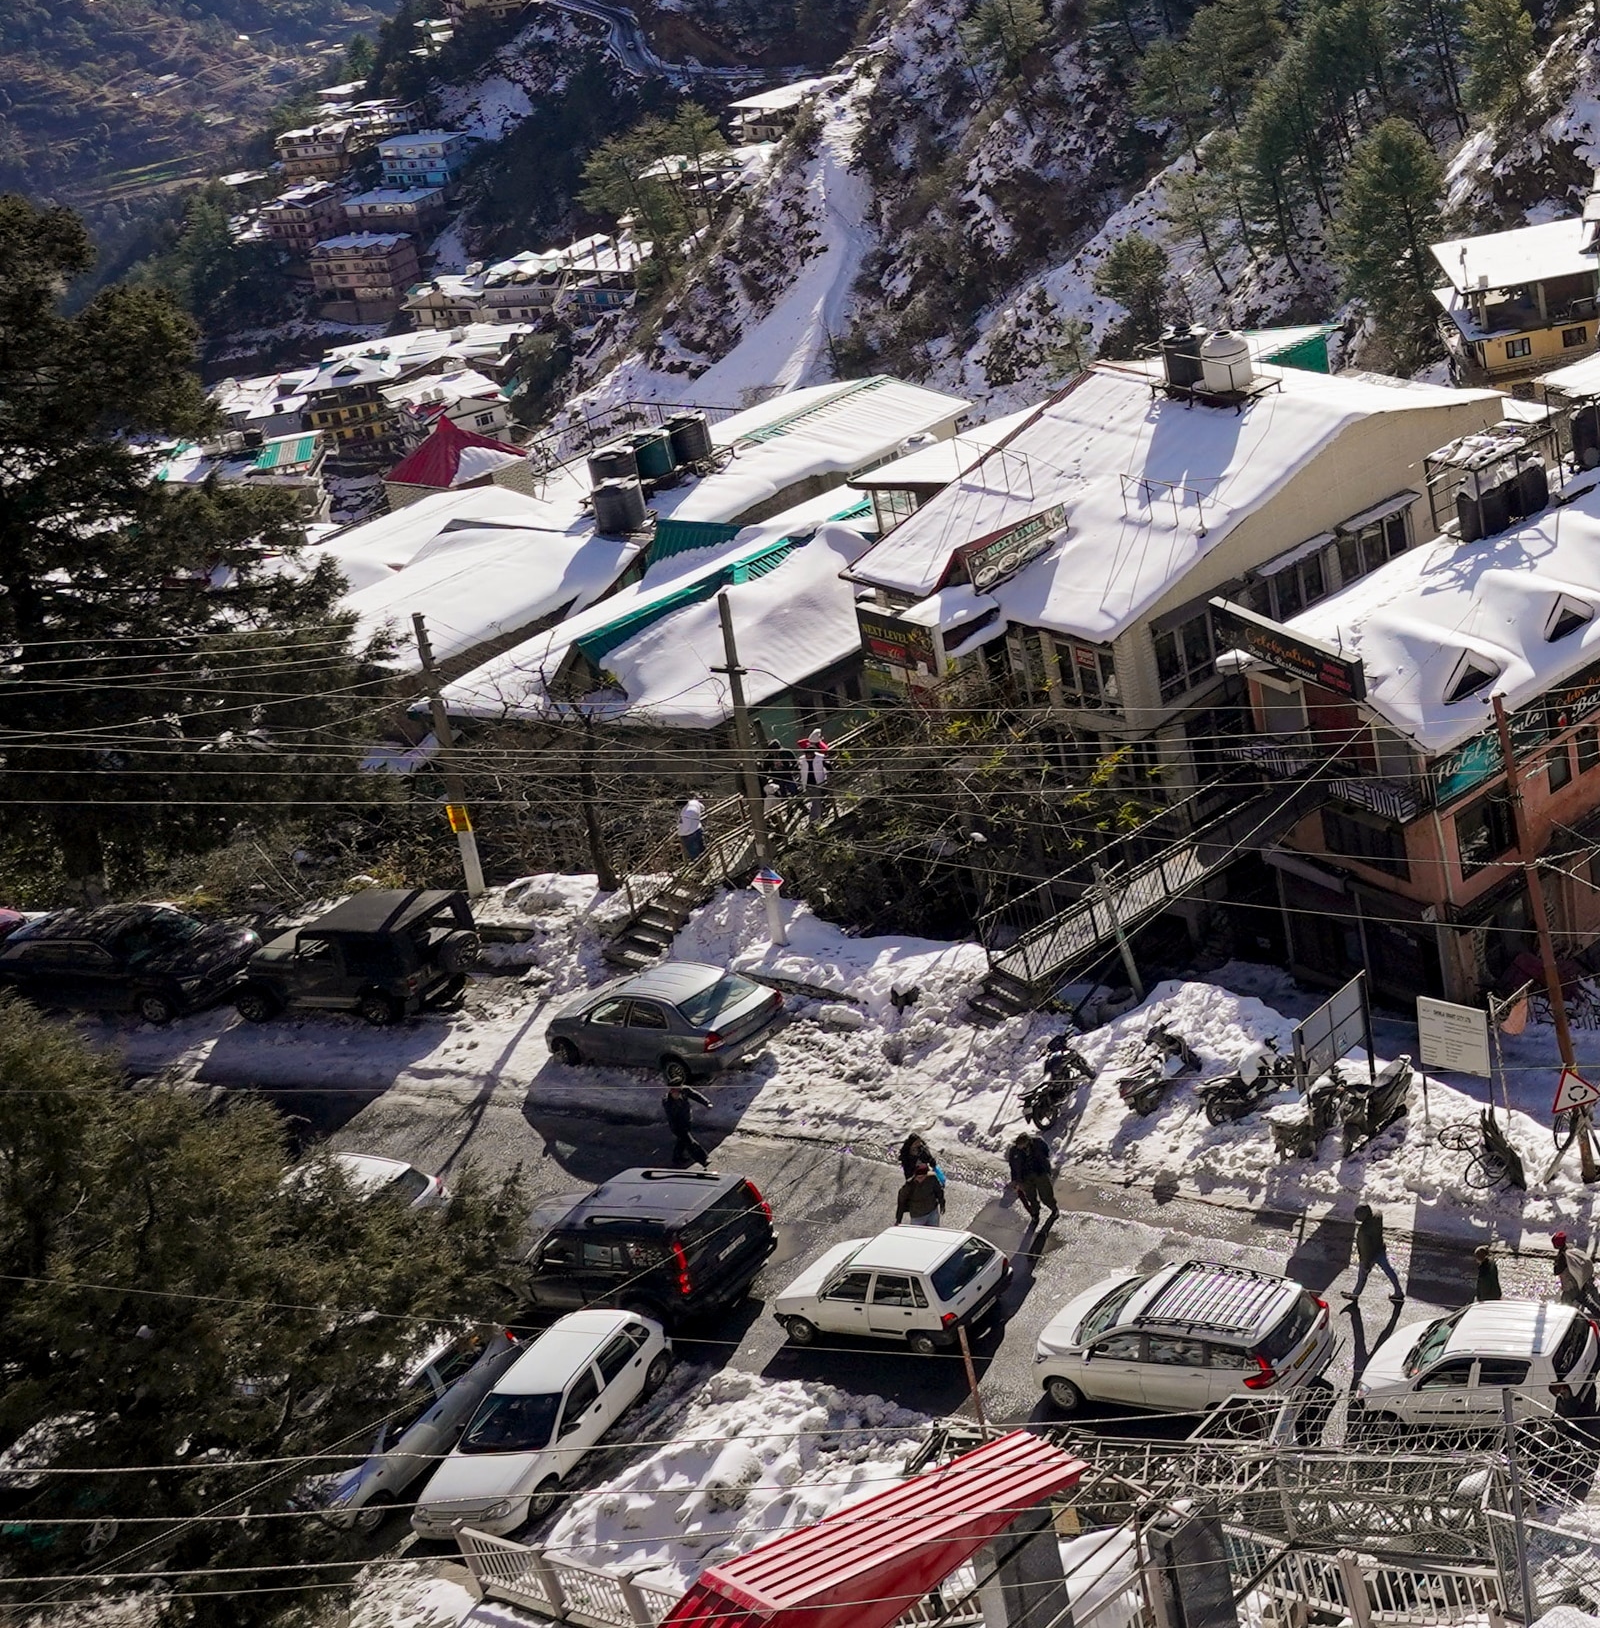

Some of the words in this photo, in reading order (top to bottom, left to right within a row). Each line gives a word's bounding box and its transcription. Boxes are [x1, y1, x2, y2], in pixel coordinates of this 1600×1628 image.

[986, 536, 1016, 556] NEXT
[1014, 519, 1043, 540] LEVEL
[862, 623, 884, 637] NEXT
[883, 628, 909, 645] LEVEL
[1274, 654, 1318, 682] Restaurant
[1437, 742, 1482, 784] Hotel
